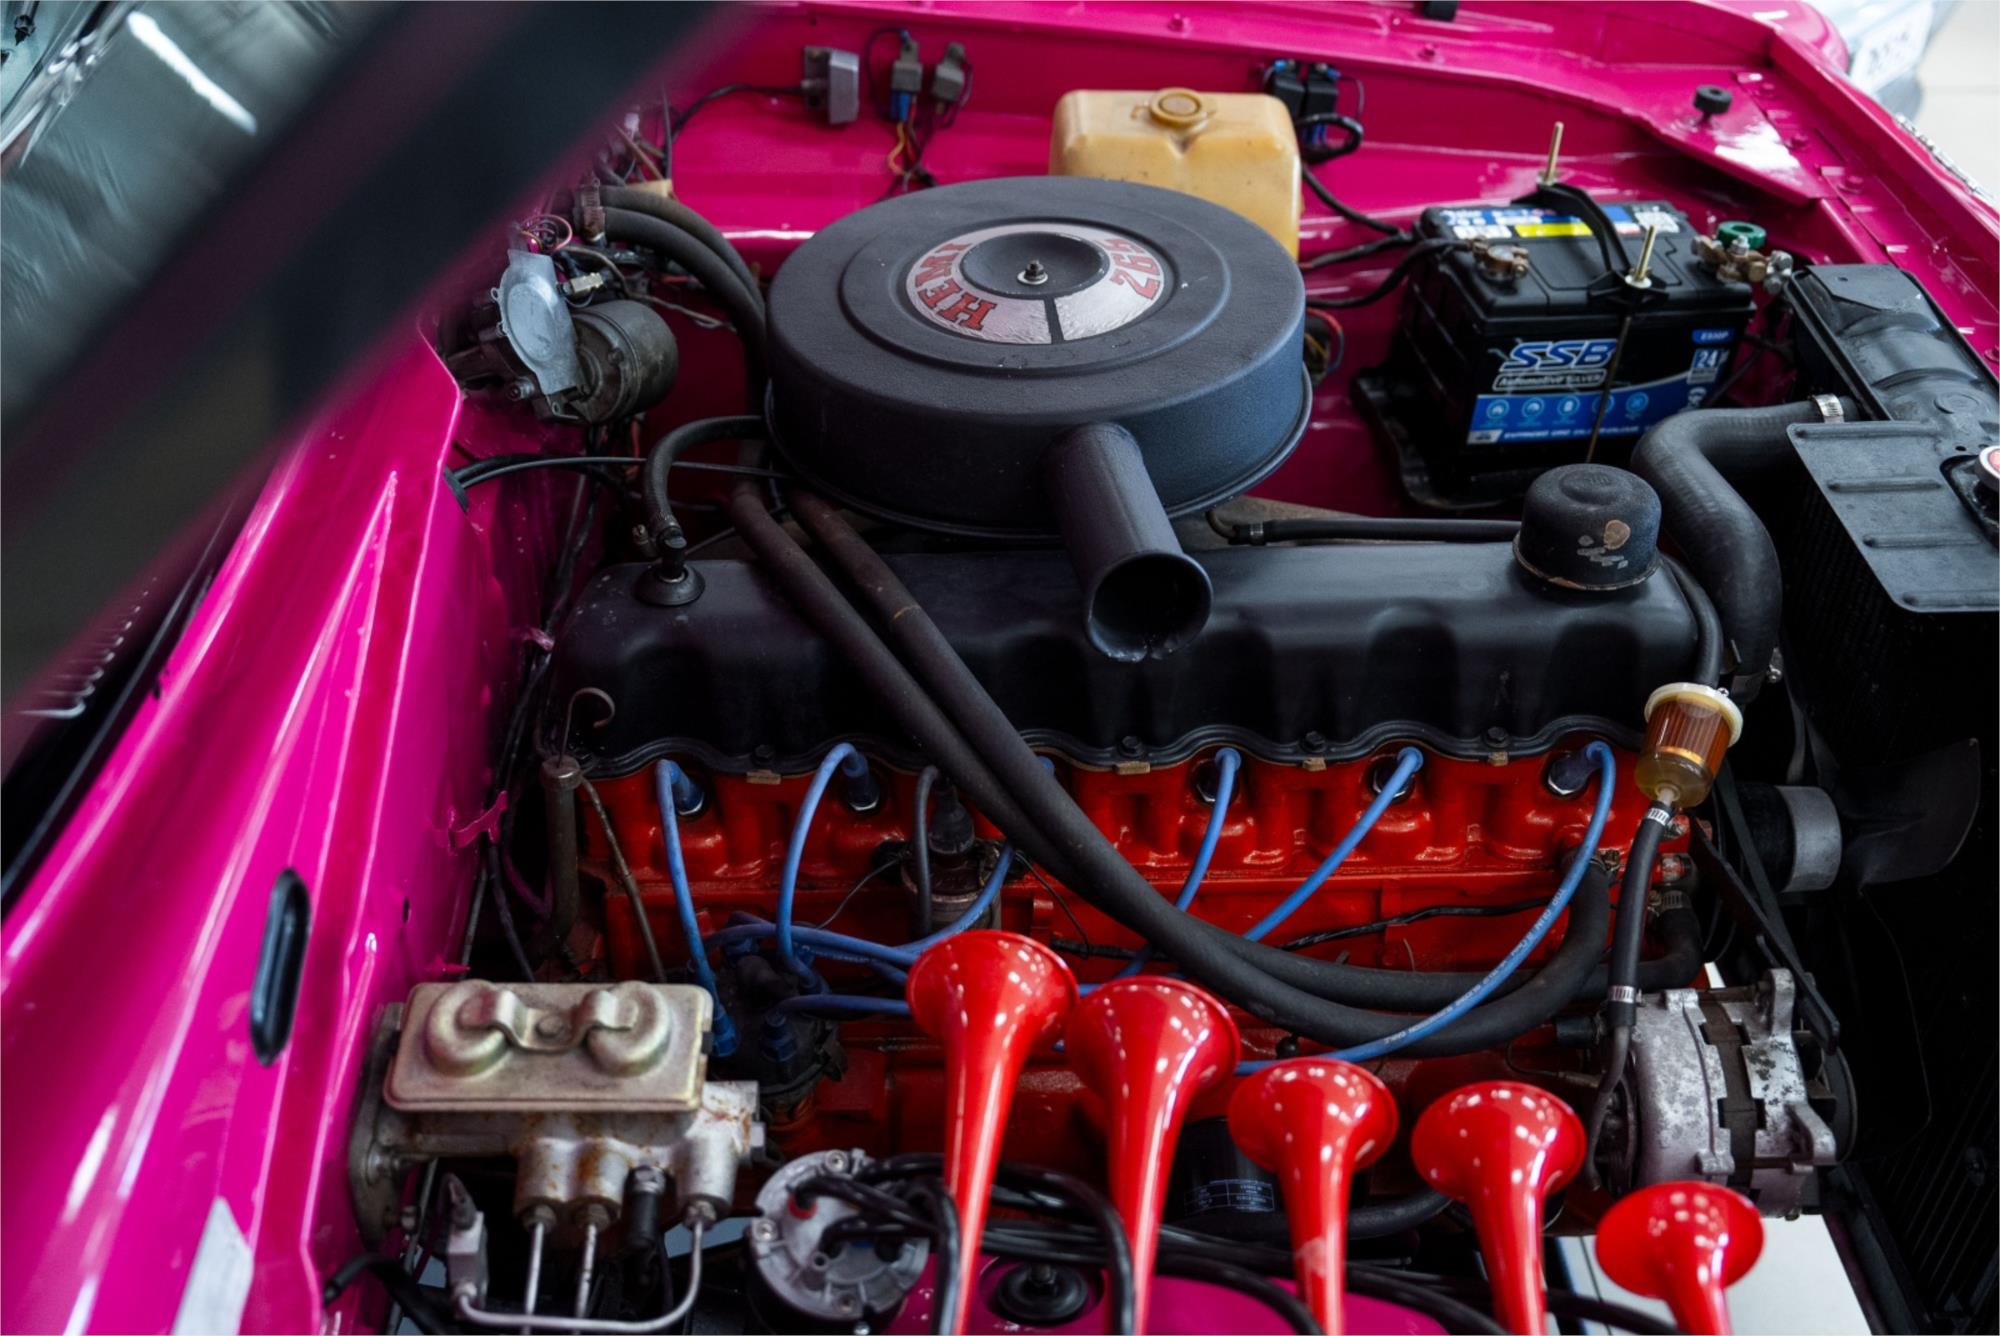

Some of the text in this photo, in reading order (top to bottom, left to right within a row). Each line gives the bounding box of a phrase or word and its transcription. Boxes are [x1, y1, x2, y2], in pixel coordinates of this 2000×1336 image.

[914, 243, 997, 331] HEMI
[1102, 239, 1160, 300] 265
[1499, 338, 1618, 371] SSB
[1696, 350, 1718, 368] 24
